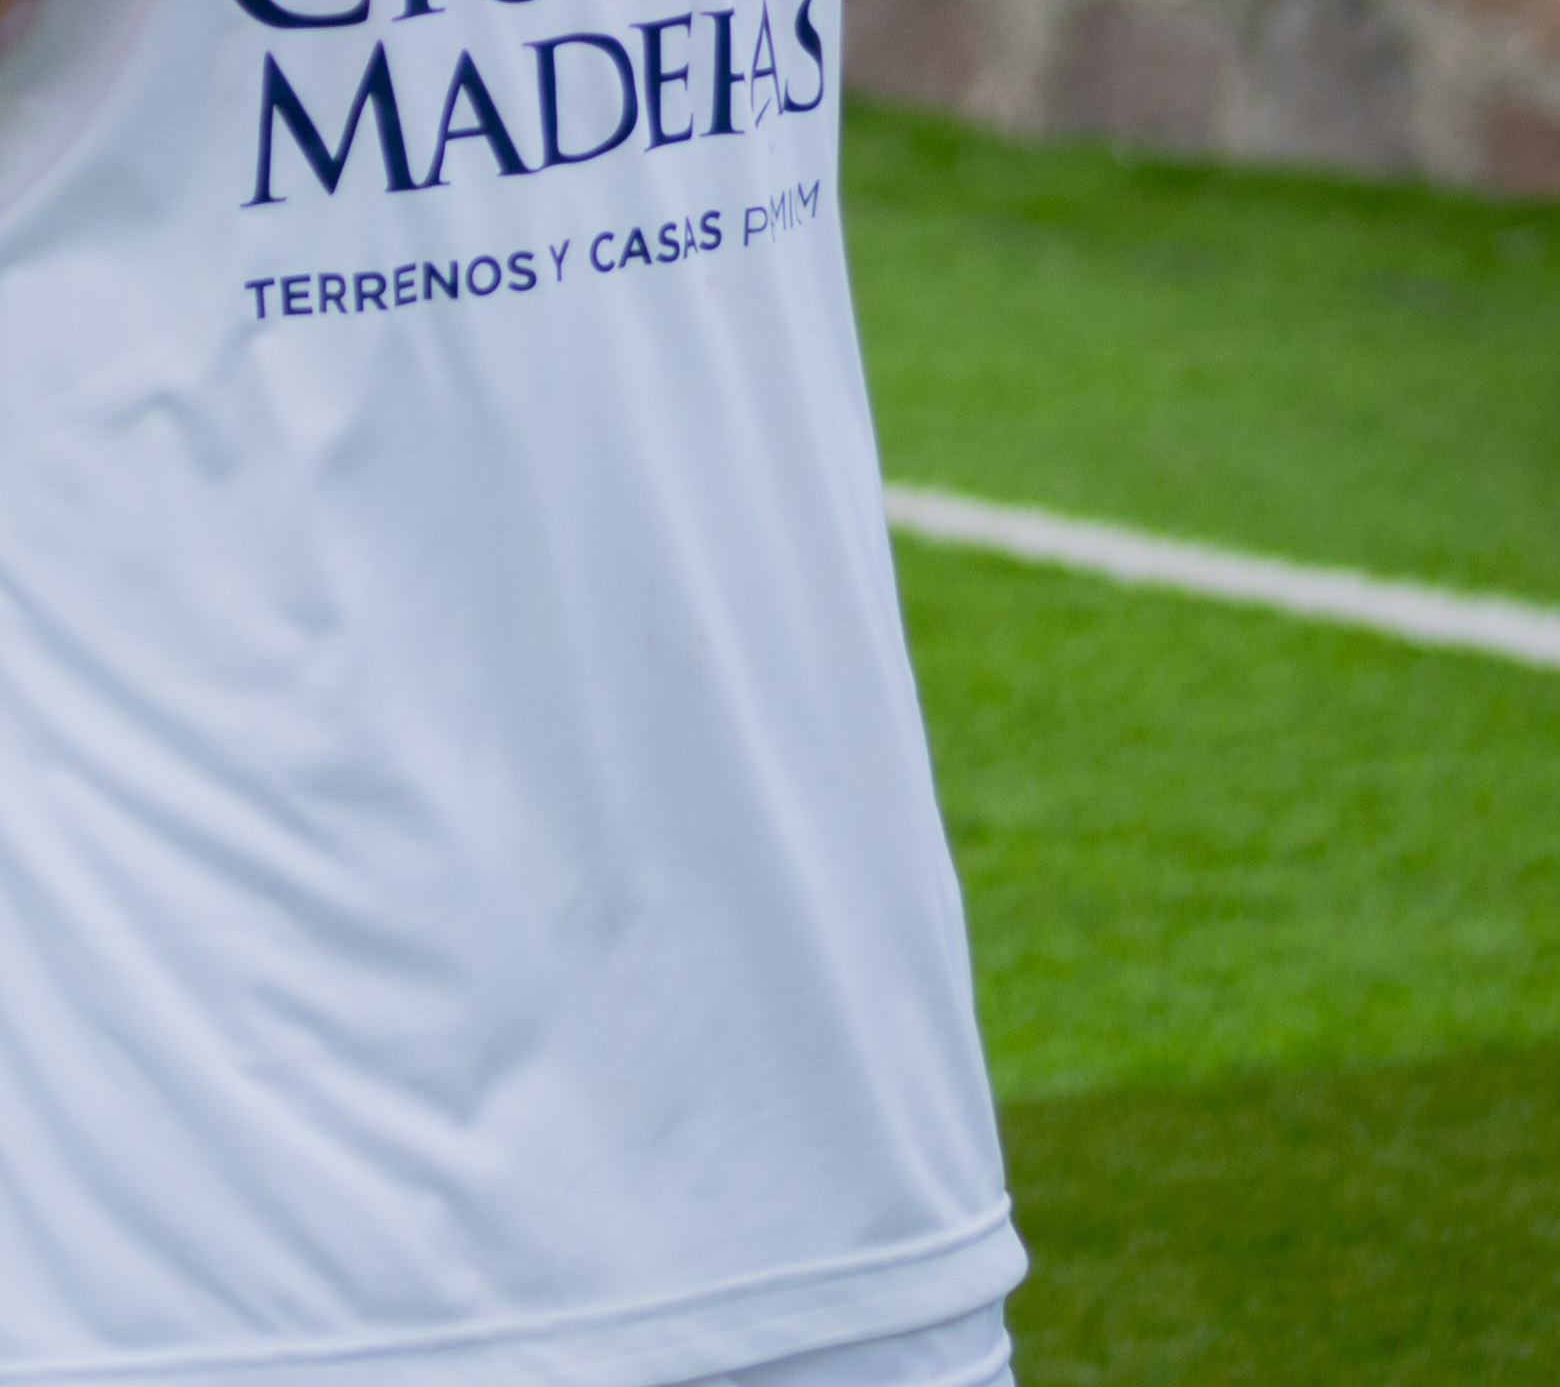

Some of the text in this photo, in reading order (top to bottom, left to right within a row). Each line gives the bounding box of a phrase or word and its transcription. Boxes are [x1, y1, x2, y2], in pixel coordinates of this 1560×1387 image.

[245, 251, 537, 320] TERRENOS
[549, 239, 570, 282] Y
[589, 210, 722, 273] CASAS
